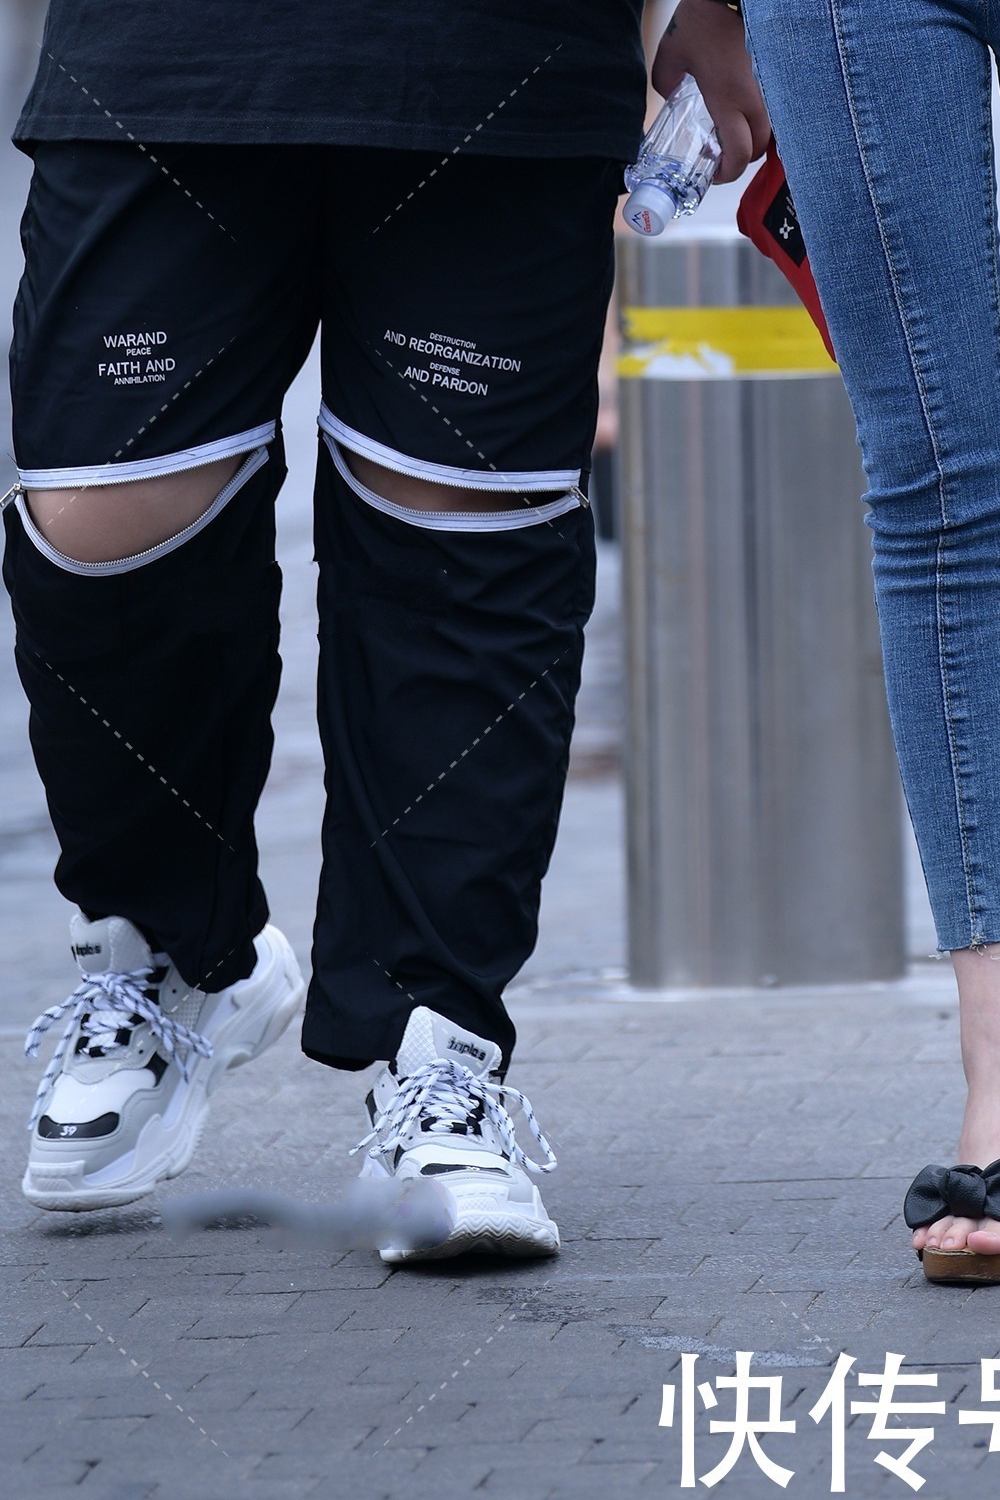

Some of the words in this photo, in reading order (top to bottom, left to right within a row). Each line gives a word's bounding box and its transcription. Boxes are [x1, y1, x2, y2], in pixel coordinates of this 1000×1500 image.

[103, 331, 167, 349] WARAND
[429, 332, 477, 350] DESTRUCTION
[126, 347, 152, 357] PEACE
[383, 329, 407, 346] AND
[408, 337, 522, 373] REORGANIZATION
[98, 361, 141, 377] FAITH
[145, 358, 176, 373] AND
[429, 362, 461, 376] DEFENSE
[403, 366, 430, 383] AND
[432, 373, 489, 397] PARDON
